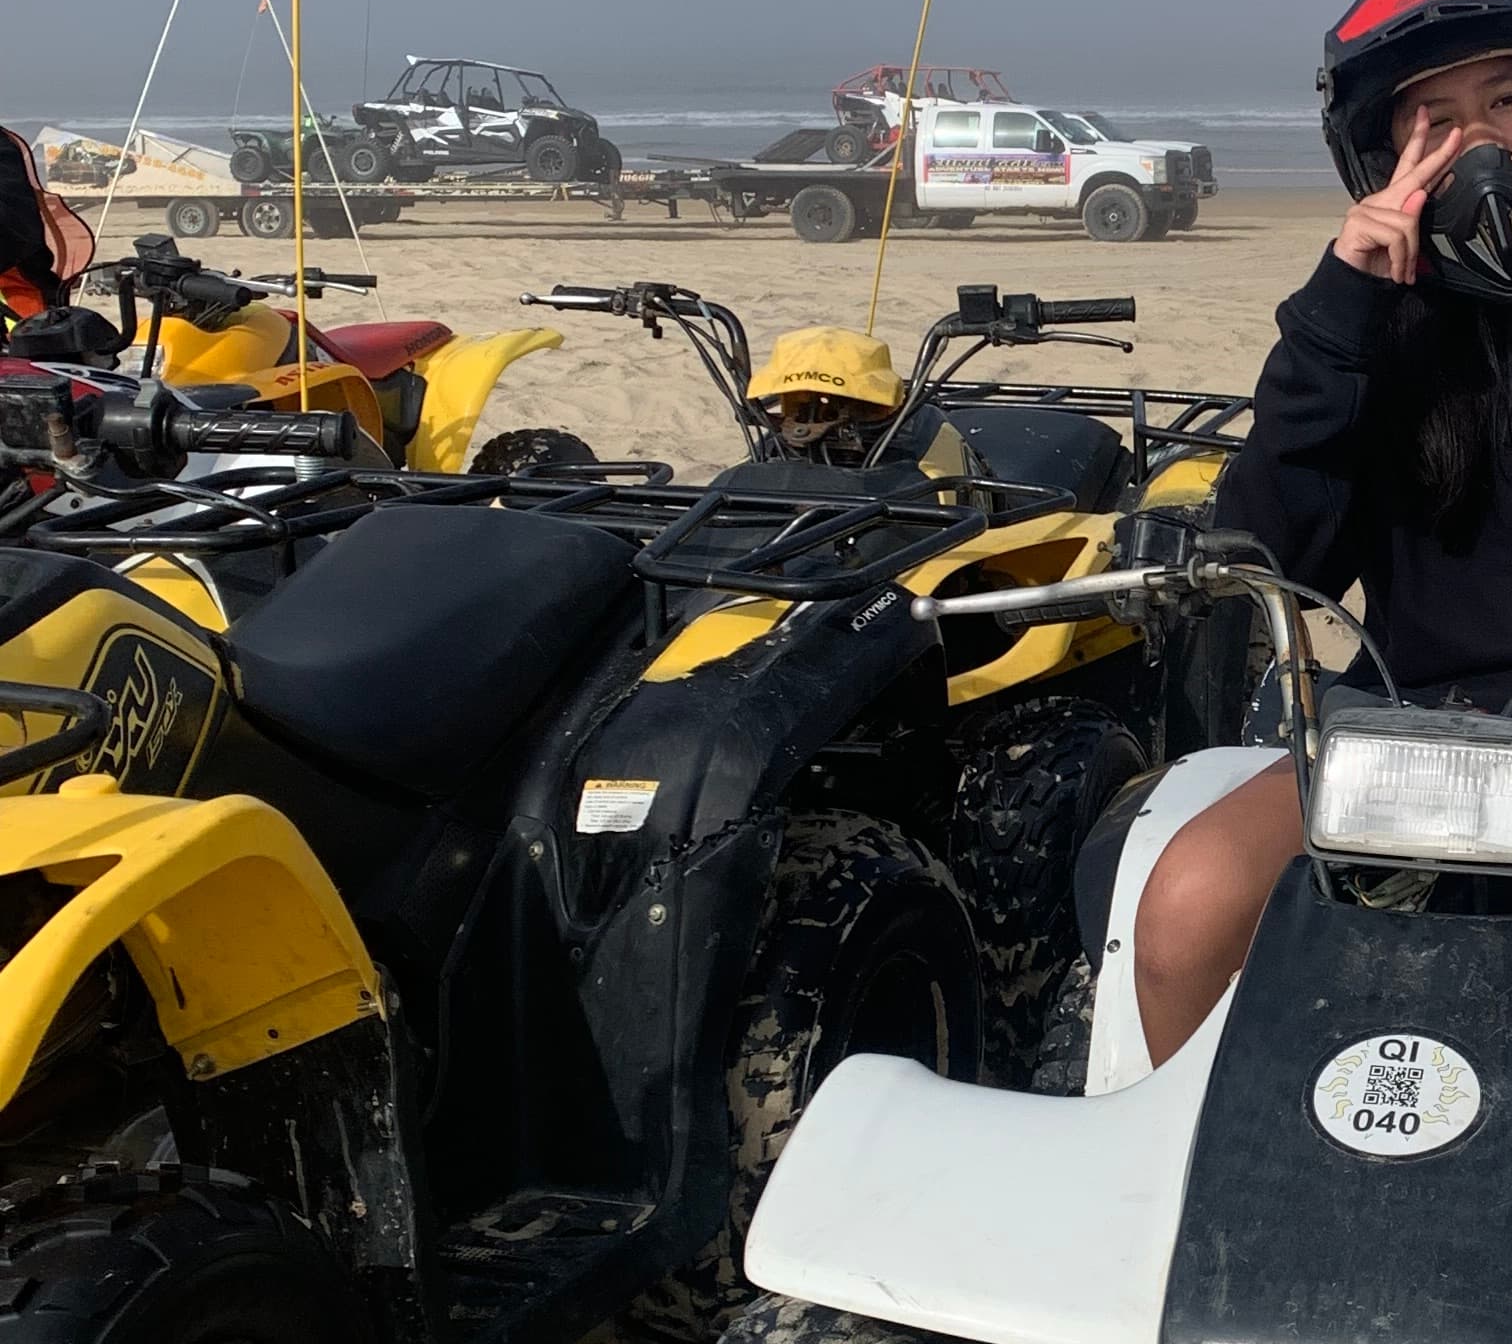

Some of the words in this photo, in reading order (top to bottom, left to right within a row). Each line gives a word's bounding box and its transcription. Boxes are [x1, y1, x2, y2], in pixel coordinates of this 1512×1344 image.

[782, 370, 846, 387] KYMCO
[862, 591, 897, 621] KYMCO
[1378, 1039, 1420, 1063] QI
[1352, 1109, 1421, 1136] 040
